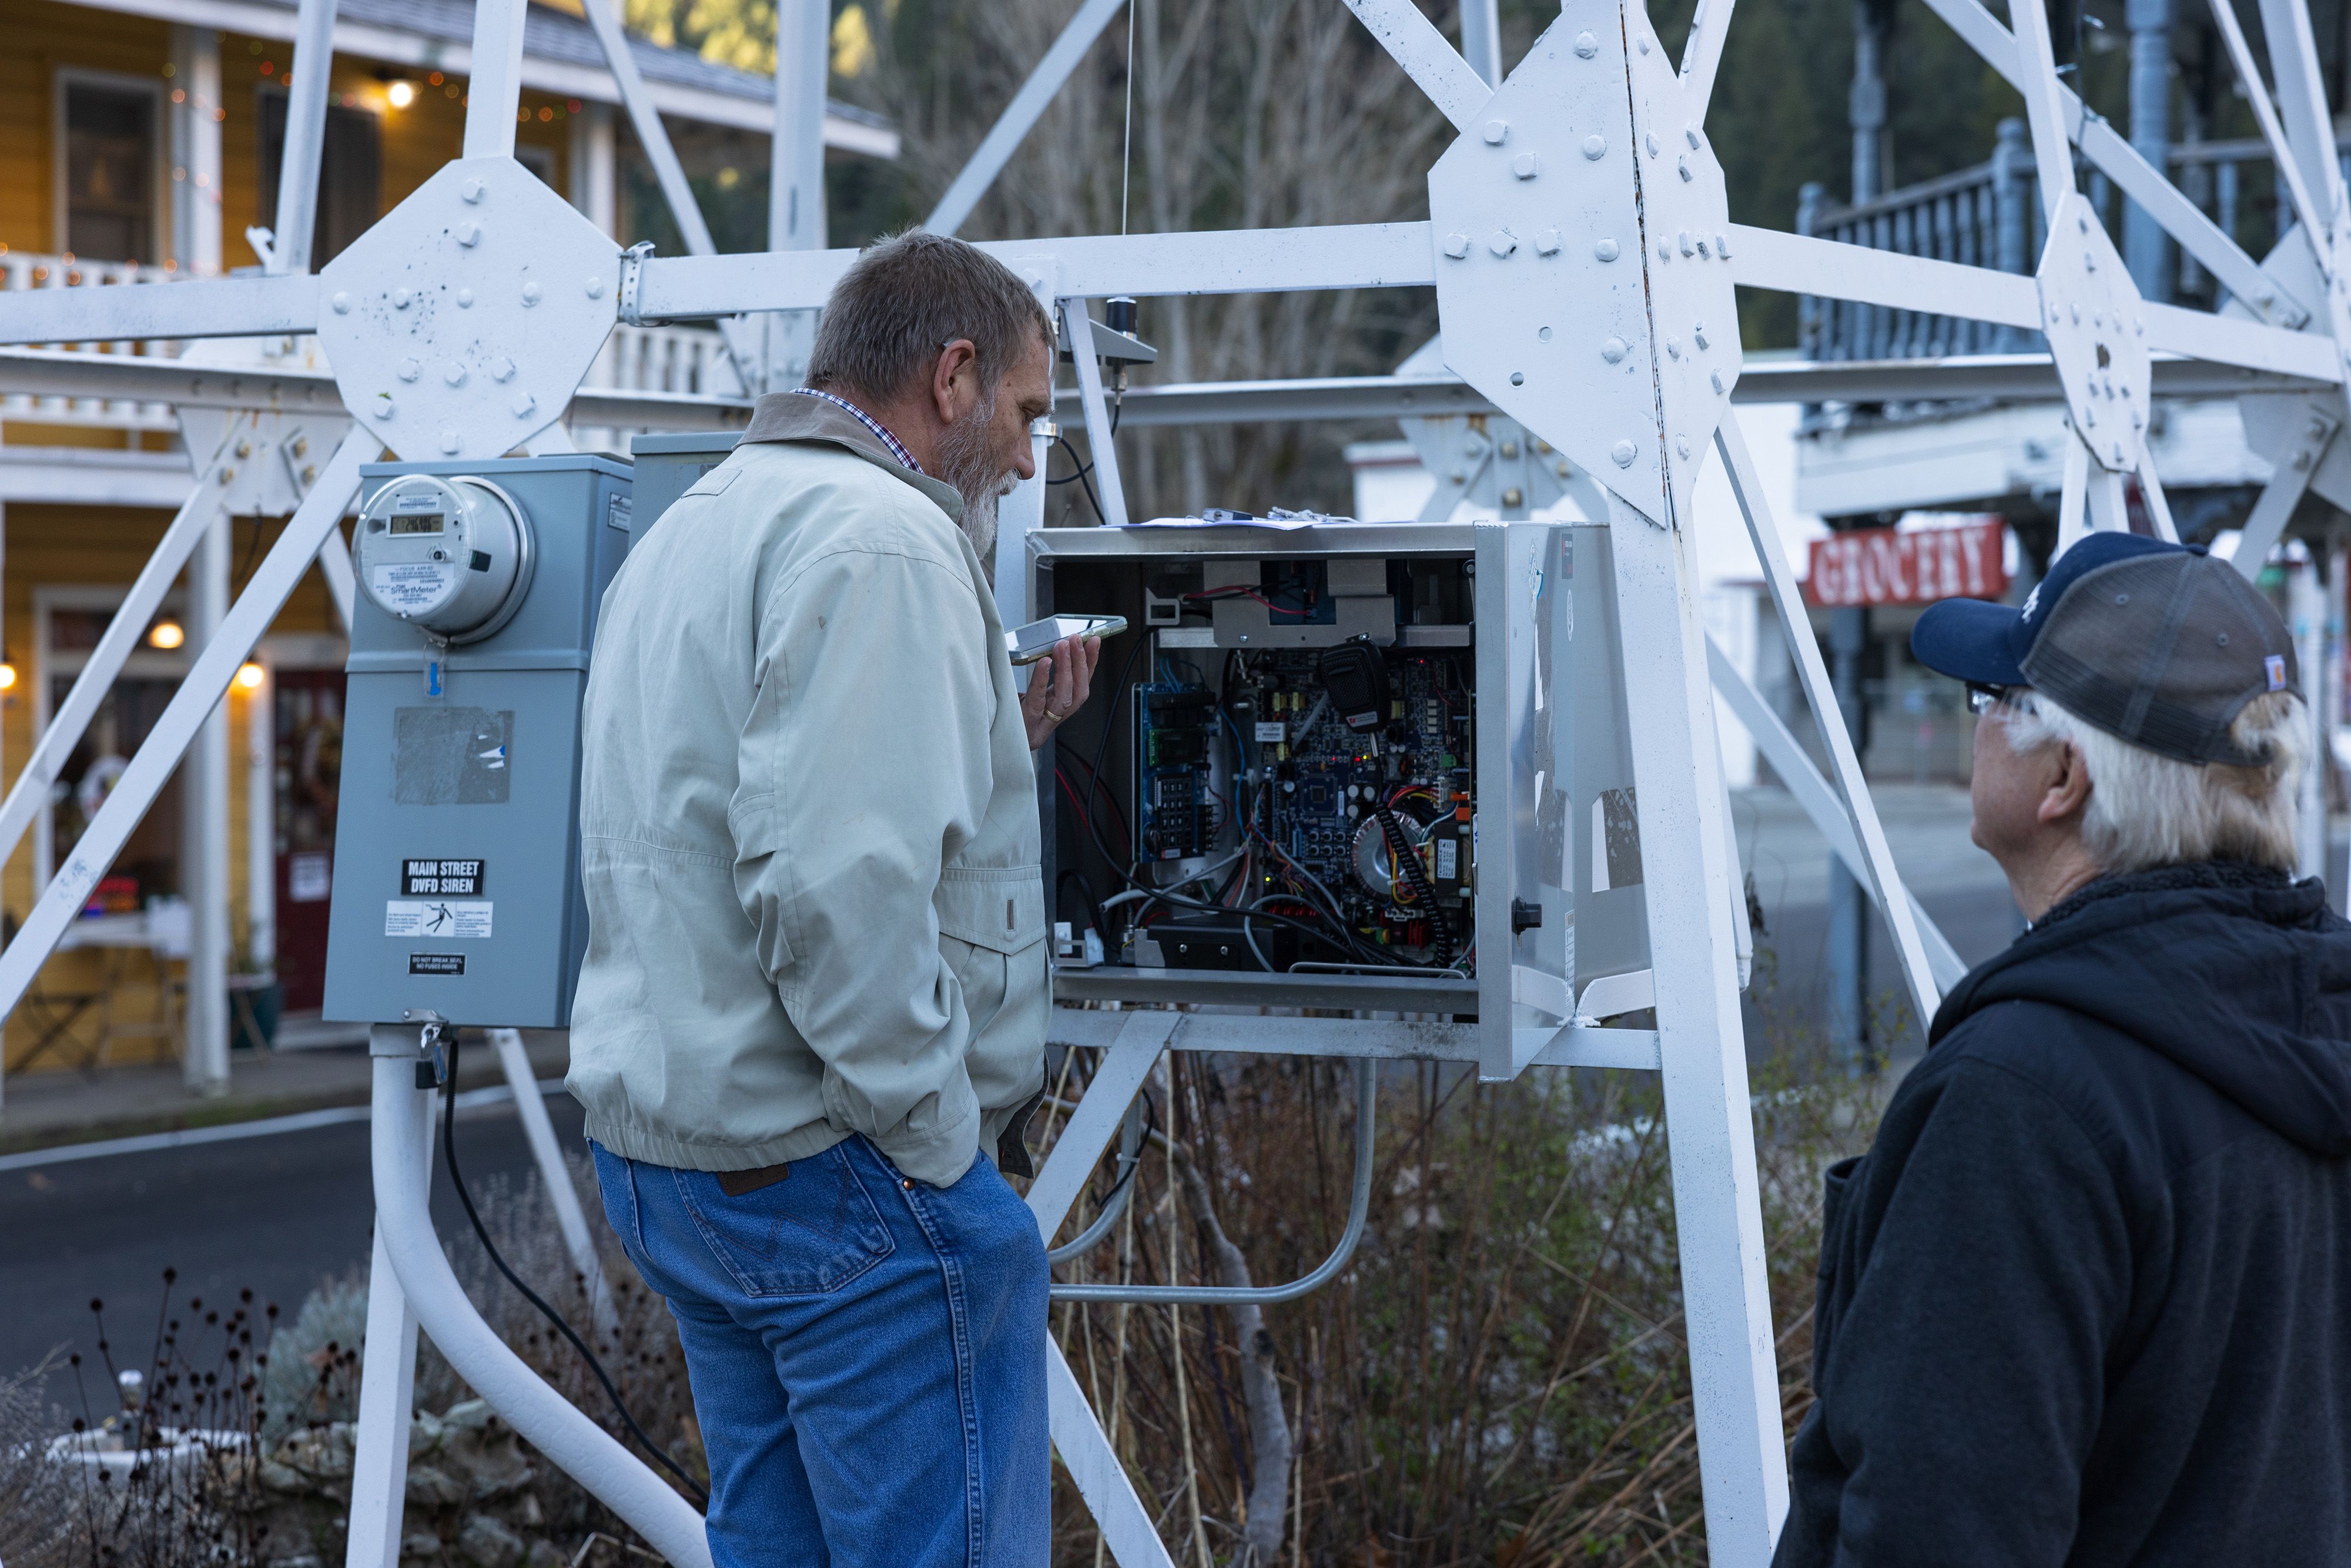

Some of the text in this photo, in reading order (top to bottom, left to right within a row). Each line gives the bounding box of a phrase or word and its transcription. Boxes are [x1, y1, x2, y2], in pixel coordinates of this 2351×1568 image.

[391, 586, 437, 594] SmartMeter
[408, 861, 480, 876] MAIN STREET
[411, 878, 474, 893] DVFD SIREN
